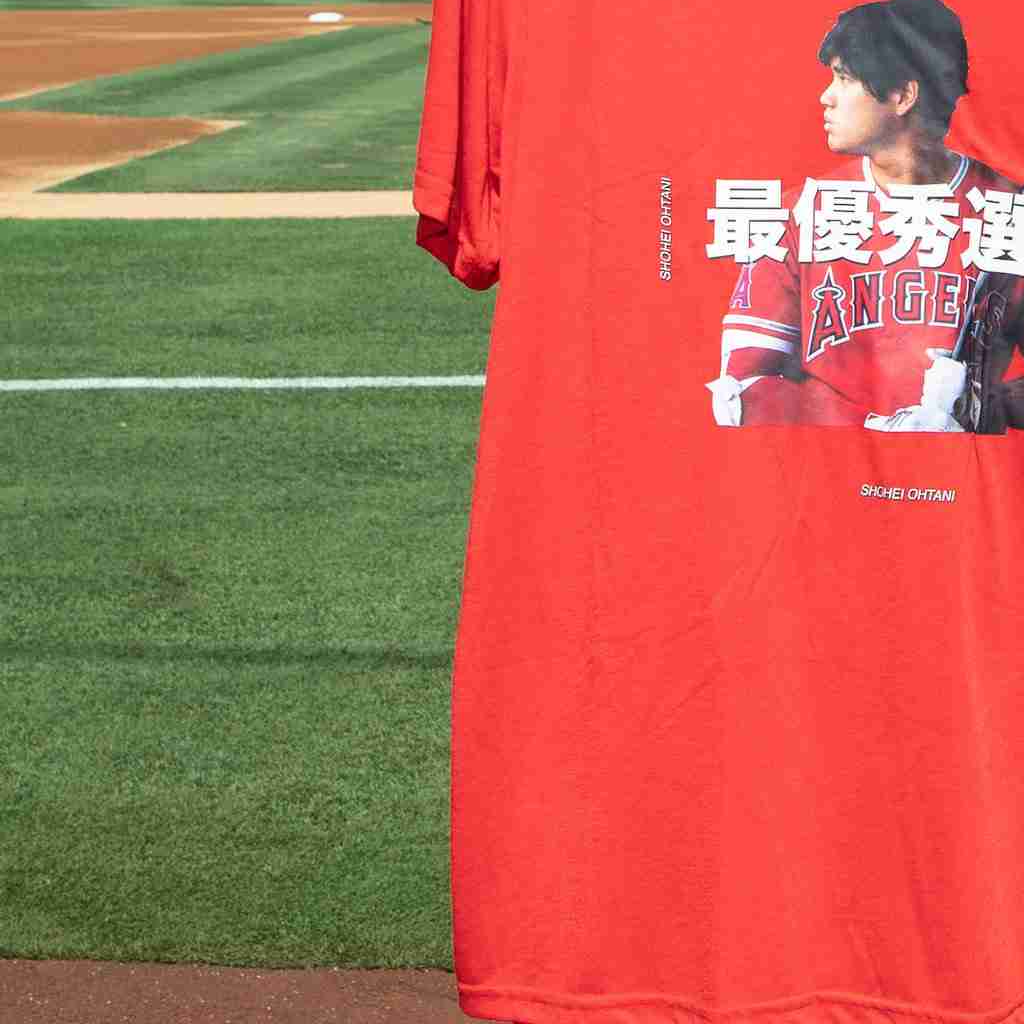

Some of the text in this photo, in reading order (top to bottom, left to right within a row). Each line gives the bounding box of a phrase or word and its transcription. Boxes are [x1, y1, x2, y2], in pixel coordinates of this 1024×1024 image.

[660, 176, 672, 281] SHOHEI OHTANI
[806, 266, 973, 363] ANGE
[860, 483, 956, 503] SHOHEI OHTANI
